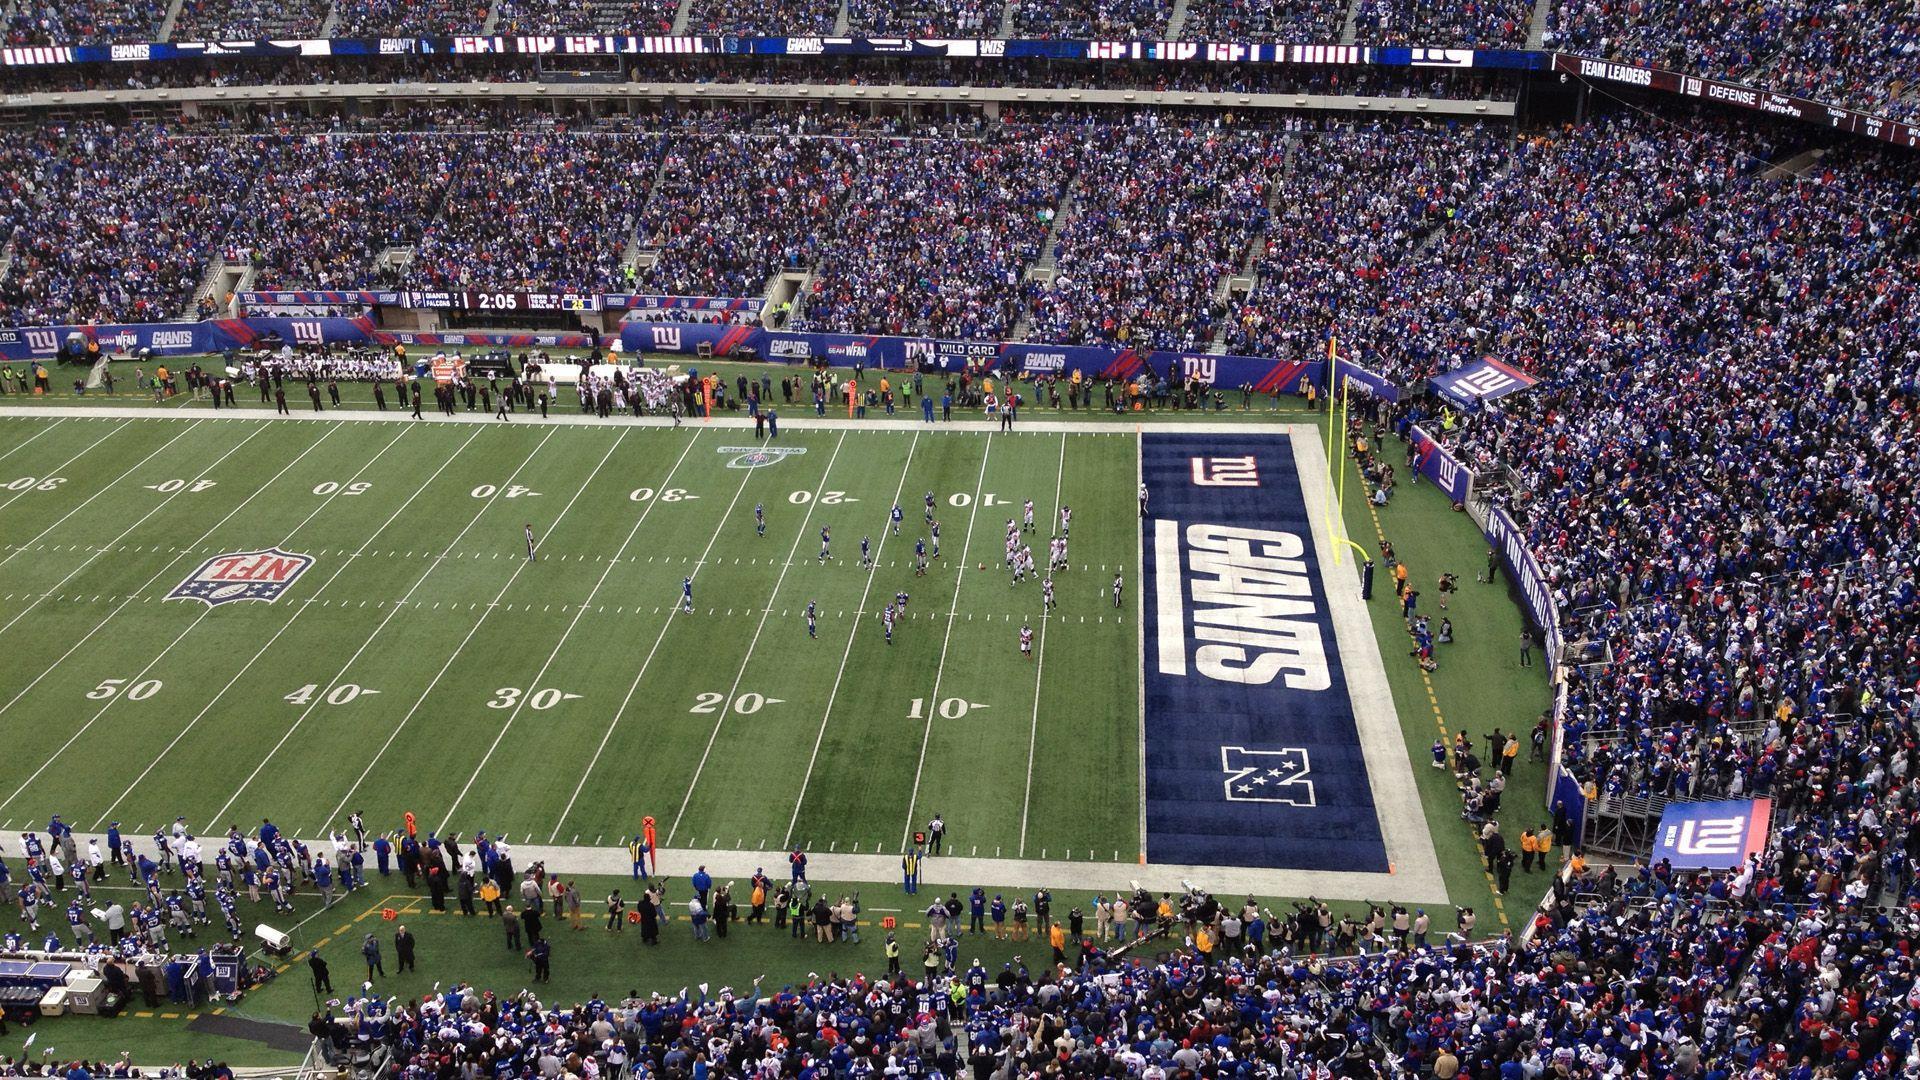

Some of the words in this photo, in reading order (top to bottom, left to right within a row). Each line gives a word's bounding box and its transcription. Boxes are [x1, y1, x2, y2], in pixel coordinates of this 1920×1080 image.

[111, 44, 150, 59] GIANTS
[1580, 60, 1606, 78] TEAM
[1607, 64, 1652, 86] LEADERS
[1709, 85, 1757, 105] DEFENSE
[1771, 95, 1790, 104] Player
[1832, 117, 1838, 127] 6
[1867, 126, 1880, 137] 0.0
[1909, 136, 1916, 147] 0
[478, 293, 517, 309] 2:05
[571, 300, 585, 310] 25
[115, 331, 137, 347] WFAN
[152, 331, 193, 348] GIANTS
[769, 339, 810, 357] GIANTS
[845, 341, 867, 357] WFAN
[939, 344, 965, 354] WILD
[967, 346, 995, 356] CARD
[1024, 352, 1066, 370] GIANTS
[312, 480, 374, 496] 50
[210, 554, 302, 581] NFL
[1186, 523, 1332, 691] GIANTS
[85, 679, 163, 701] 50
[283, 683, 362, 705] 40
[487, 688, 564, 710] 30
[689, 692, 767, 714] 20
[906, 697, 969, 720] 10
[915, 833, 924, 842] 3
[918, 1002, 930, 1013] 10
[936, 1000, 946, 1010] 10
[908, 1064, 918, 1074] 10
